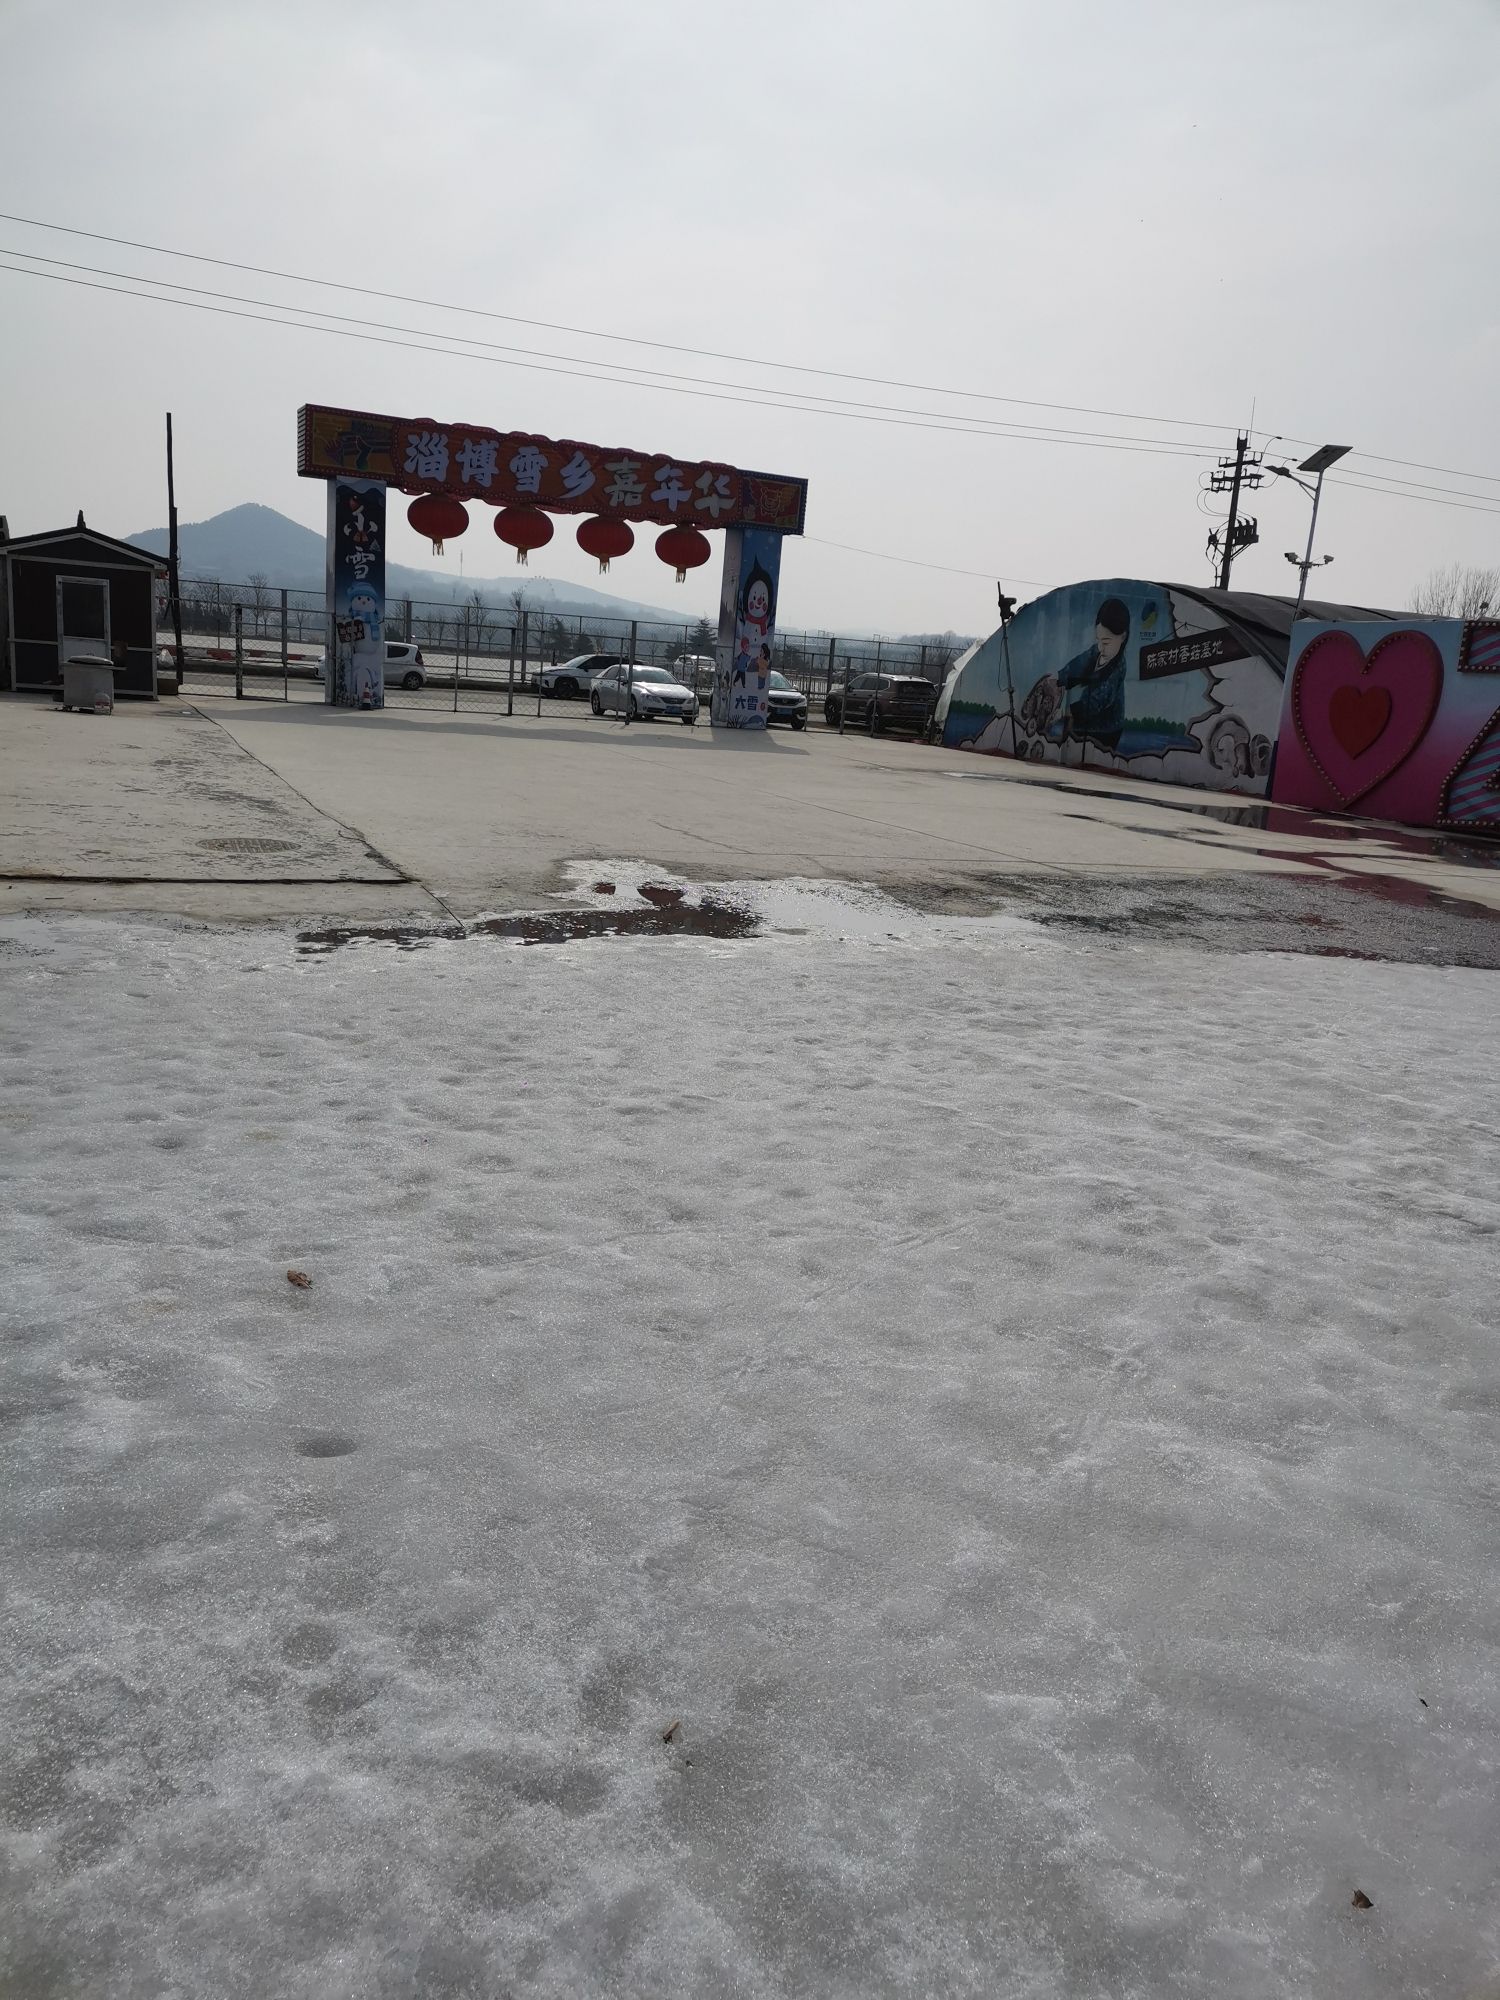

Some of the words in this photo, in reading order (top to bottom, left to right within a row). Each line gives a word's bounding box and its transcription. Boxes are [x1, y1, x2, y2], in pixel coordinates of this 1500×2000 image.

[404, 431, 736, 518] 淄博雪乡嘉年华
[343, 505, 378, 579] 小雪
[1147, 640, 1224, 669] 陈家村香菇基地
[735, 695, 758, 711] 大雪
